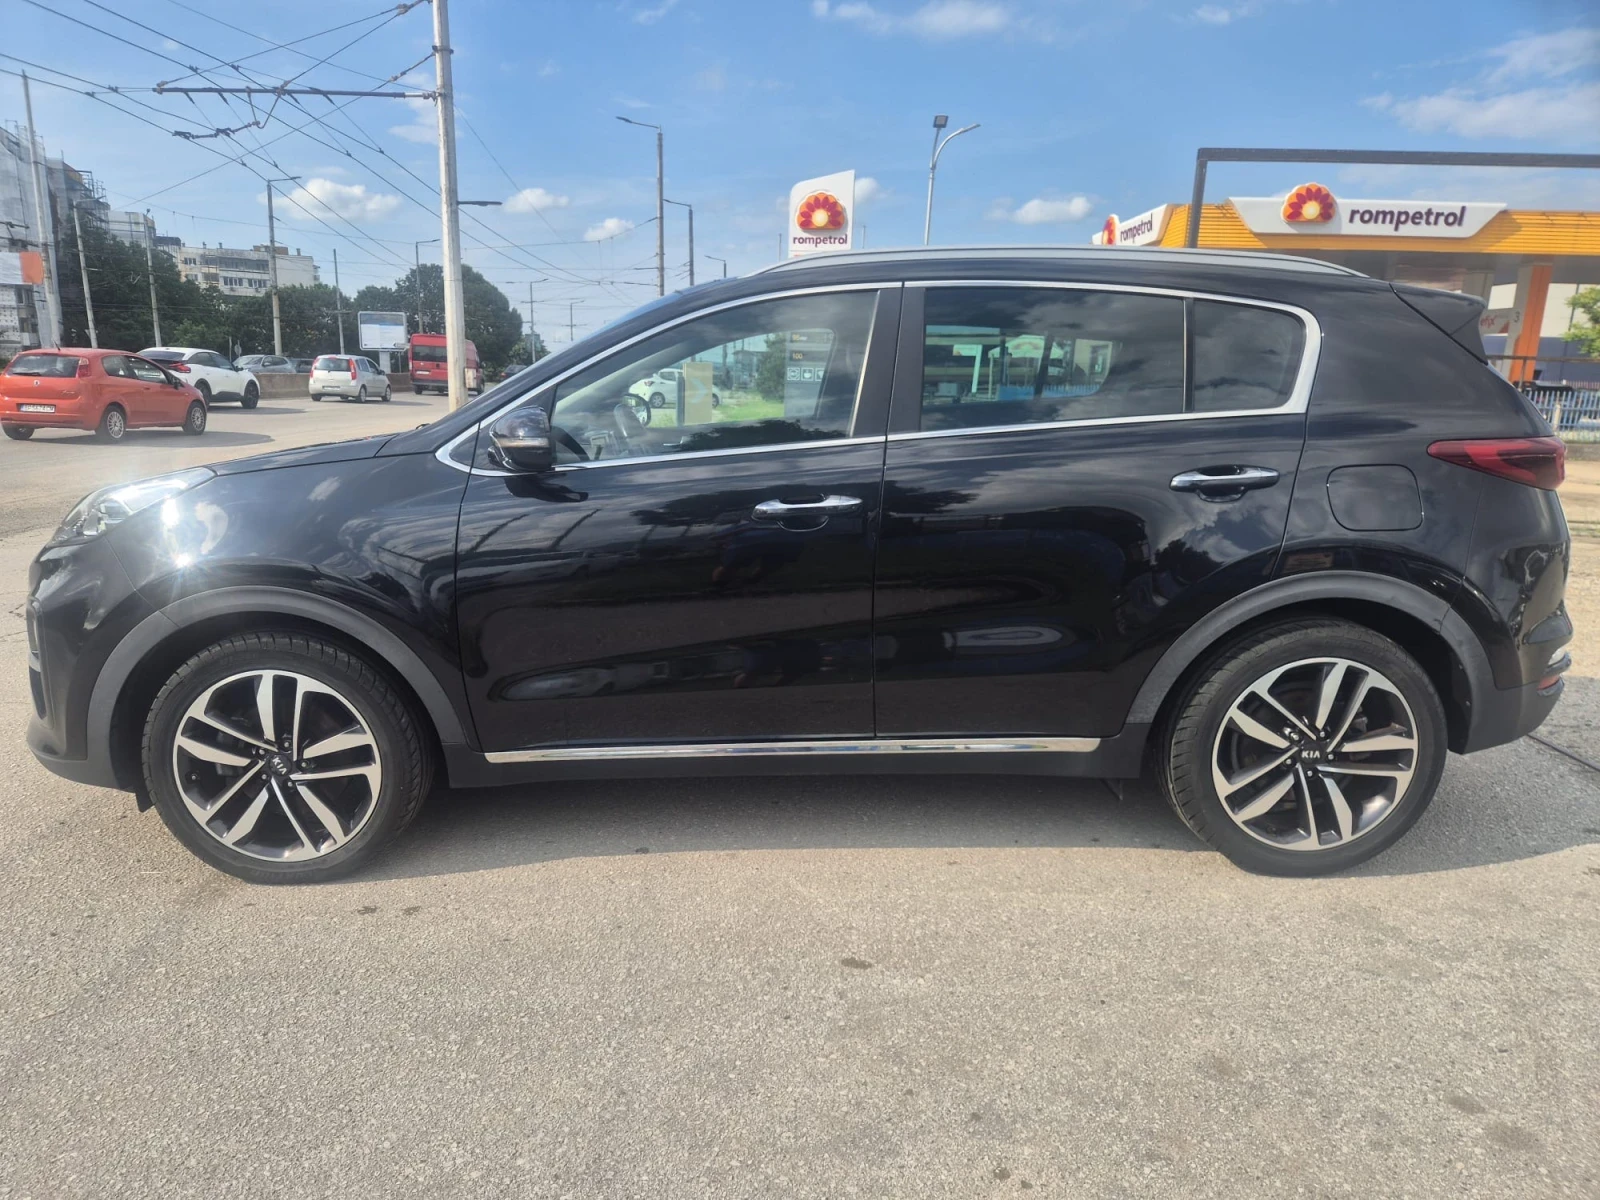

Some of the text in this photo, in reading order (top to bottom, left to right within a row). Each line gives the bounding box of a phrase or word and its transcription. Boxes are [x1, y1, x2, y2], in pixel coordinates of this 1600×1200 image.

[1347, 205, 1466, 231] rompetrol
[1120, 212, 1153, 244] rompetrol
[793, 233, 848, 248] rompetrol
[1301, 750, 1321, 759] KIA
[272, 757, 287, 775] KIA
